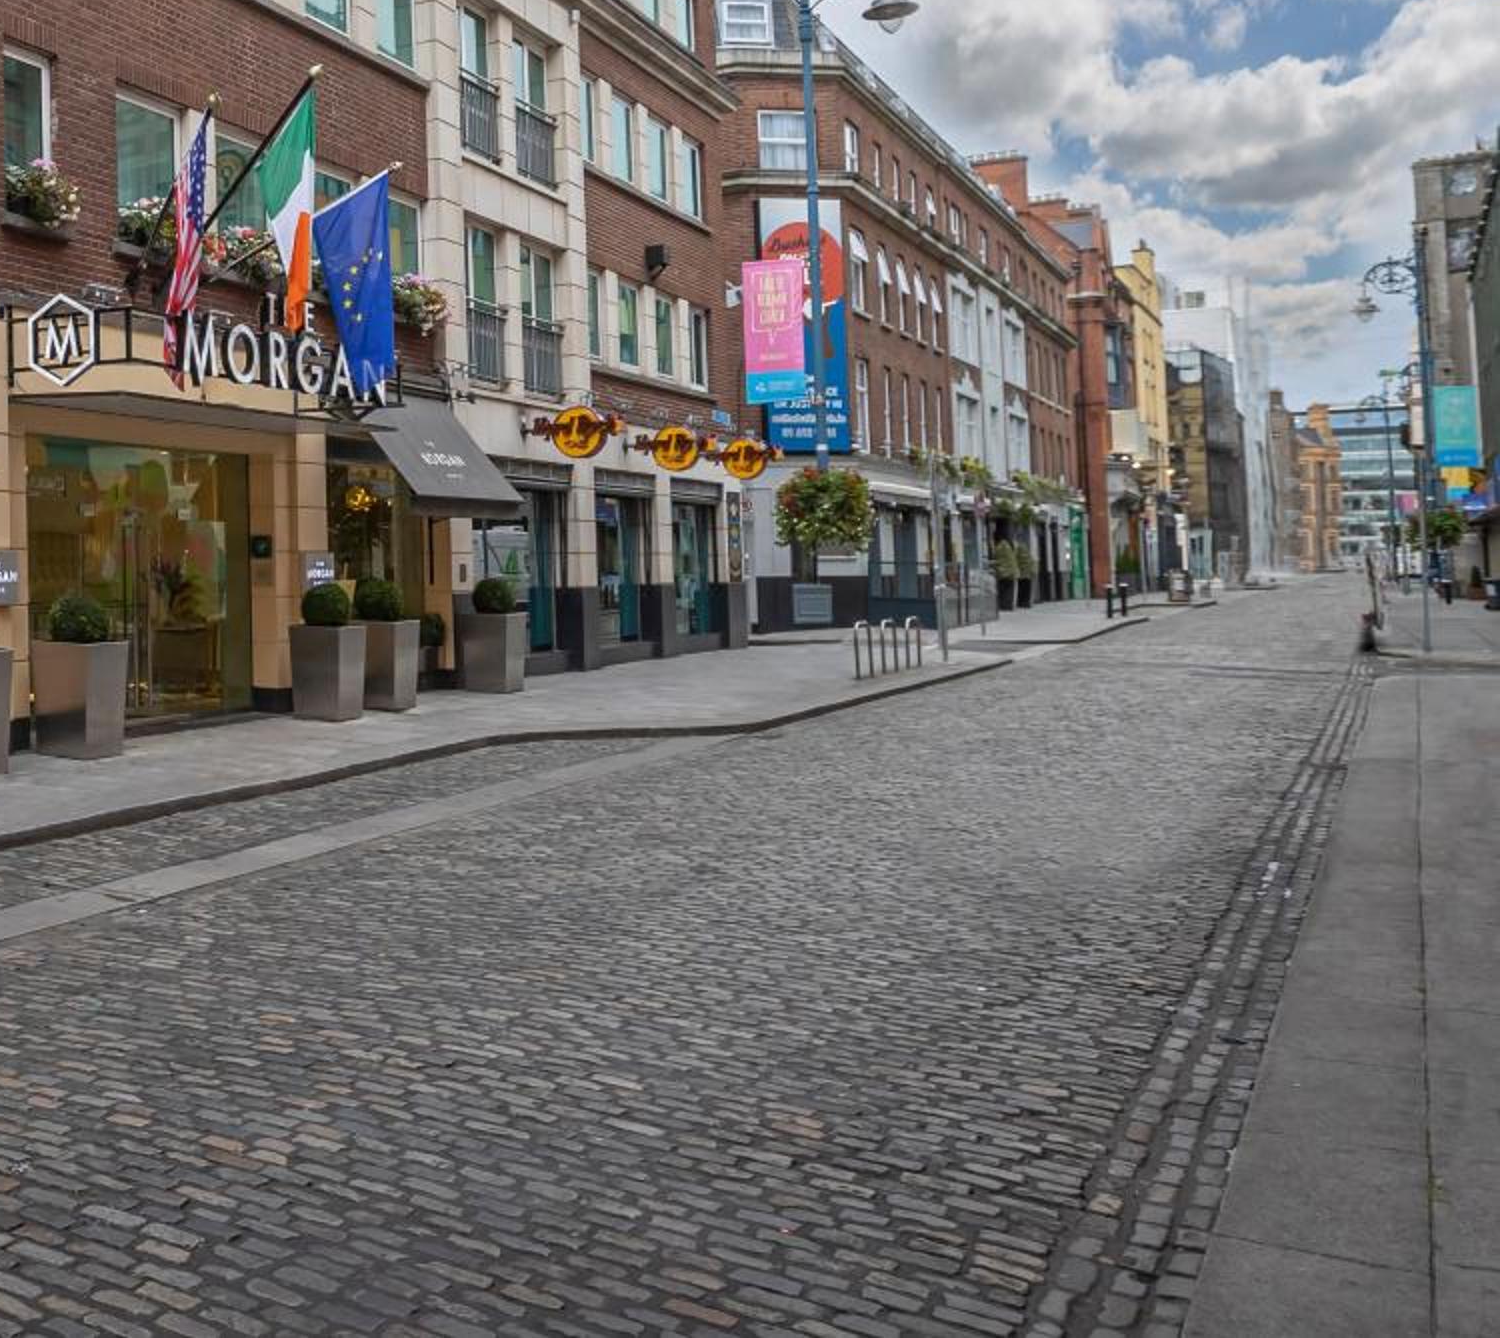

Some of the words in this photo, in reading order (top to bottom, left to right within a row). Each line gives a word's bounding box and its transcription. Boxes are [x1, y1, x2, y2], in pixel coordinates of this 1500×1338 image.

[265, 291, 316, 334] TE
[45, 315, 80, 364] M
[183, 310, 387, 407] MORGAN
